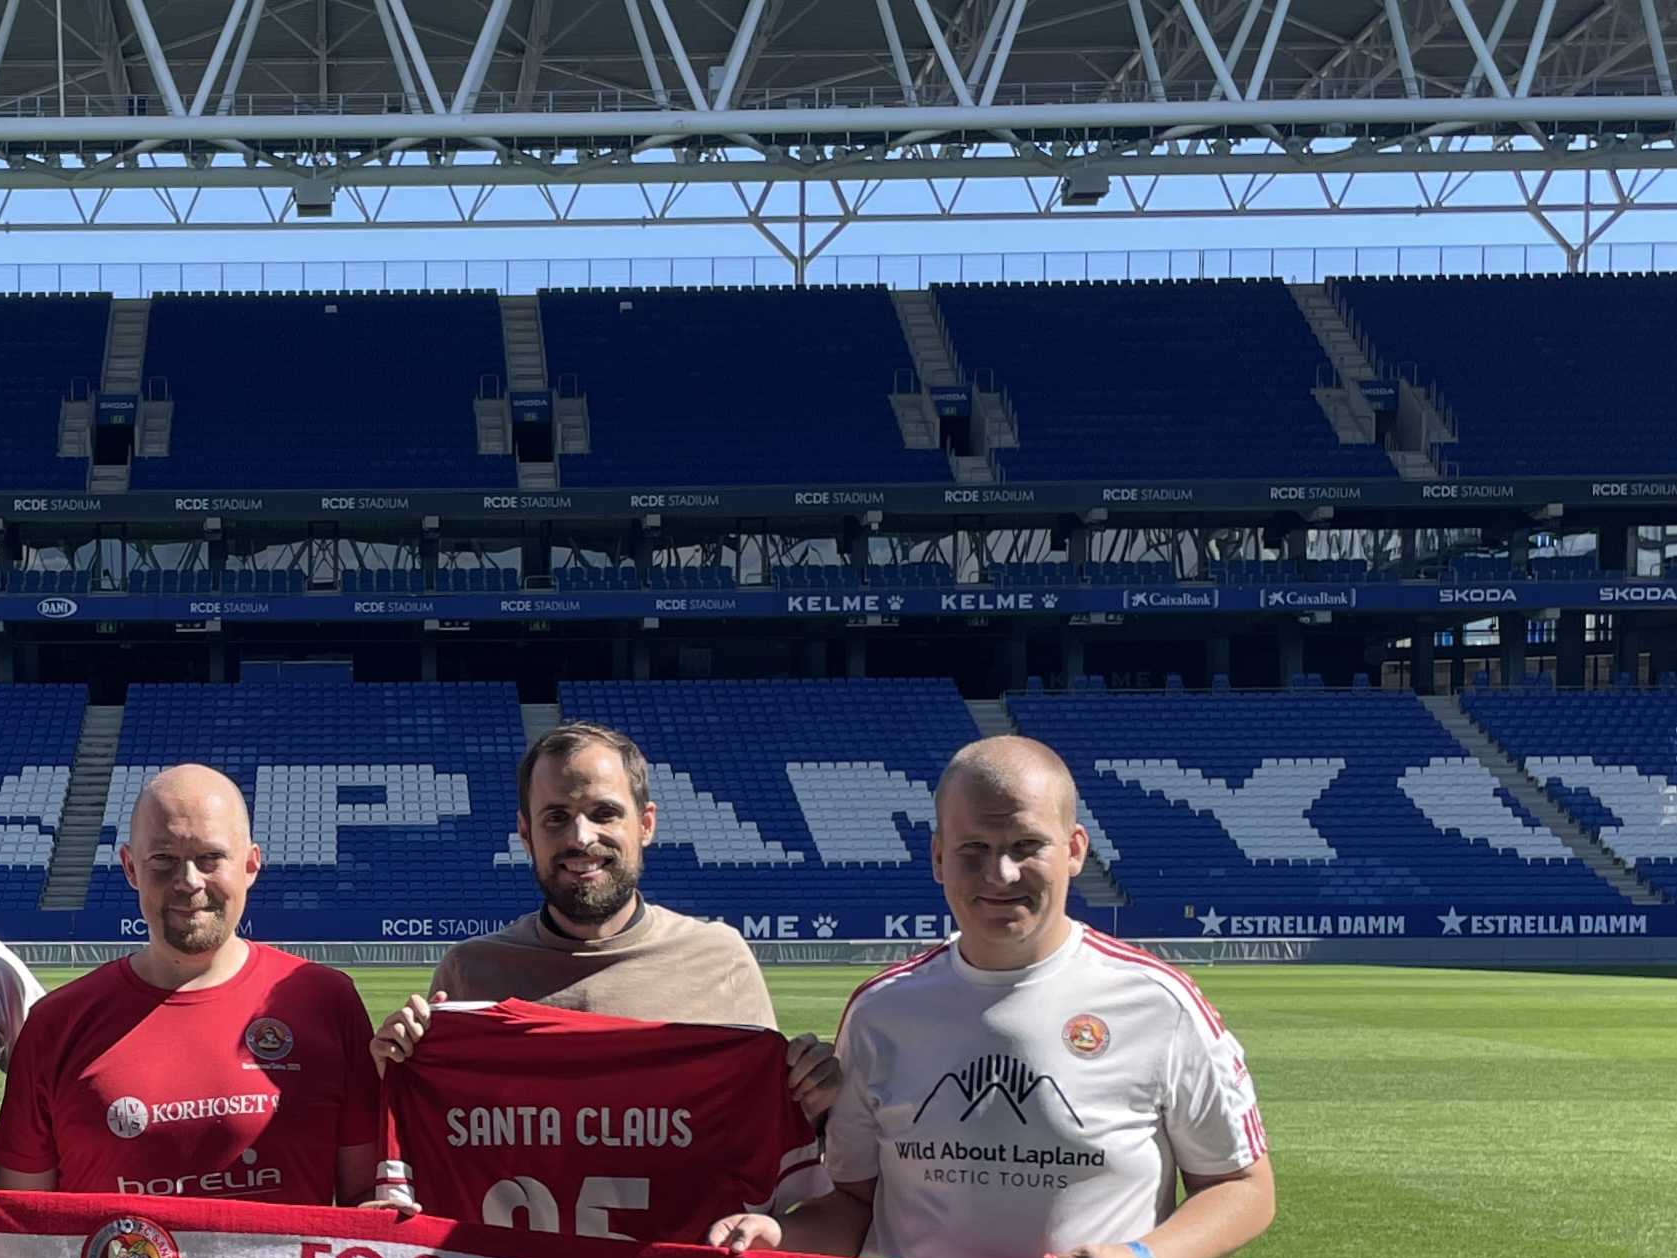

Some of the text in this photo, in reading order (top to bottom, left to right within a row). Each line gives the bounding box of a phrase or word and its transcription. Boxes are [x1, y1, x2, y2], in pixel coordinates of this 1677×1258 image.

[944, 490, 1035, 503] RCDE STADIUM
[1102, 488, 1193, 501] RCDE STADIUM
[1270, 487, 1361, 500] RCDE STADIUM
[1422, 485, 1514, 498] RCDE STADIUM
[1592, 483, 1628, 497] RCDE
[13, 498, 101, 511] RCDE STADIUM
[175, 498, 263, 511] RCDE STADIUM
[321, 497, 409, 510] RCDE STADIUM
[483, 496, 572, 509] RCDE STADIUM
[630, 494, 720, 508] RCDE STADIUM
[795, 492, 885, 505] RCDE STADIUM
[941, 593, 1033, 610] KELME
[1148, 592, 1211, 606] CaixaBank
[1285, 591, 1348, 605] CaixaBank
[1439, 588, 1517, 603] SKODA
[41, 601, 70, 614] DANI
[190, 602, 269, 614] RCDE STADIUM
[354, 601, 434, 613] RCDE STADIUM
[500, 600, 581, 612] RCDE STADIUM
[655, 599, 736, 611] RCDE STADIUM
[787, 595, 880, 612] KELME
[382, 919, 433, 936] RCDE
[1230, 915, 1405, 935] ESTRELLA DAMM
[1470, 915, 1647, 934] ESTRELLA DAMM
[150, 1094, 268, 1124] KORHOSET
[445, 1106, 693, 1148] SANTA CLAUS
[895, 1141, 1105, 1168] Wild About Lapland
[924, 1169, 1069, 1189] ARCTIC TOURS
